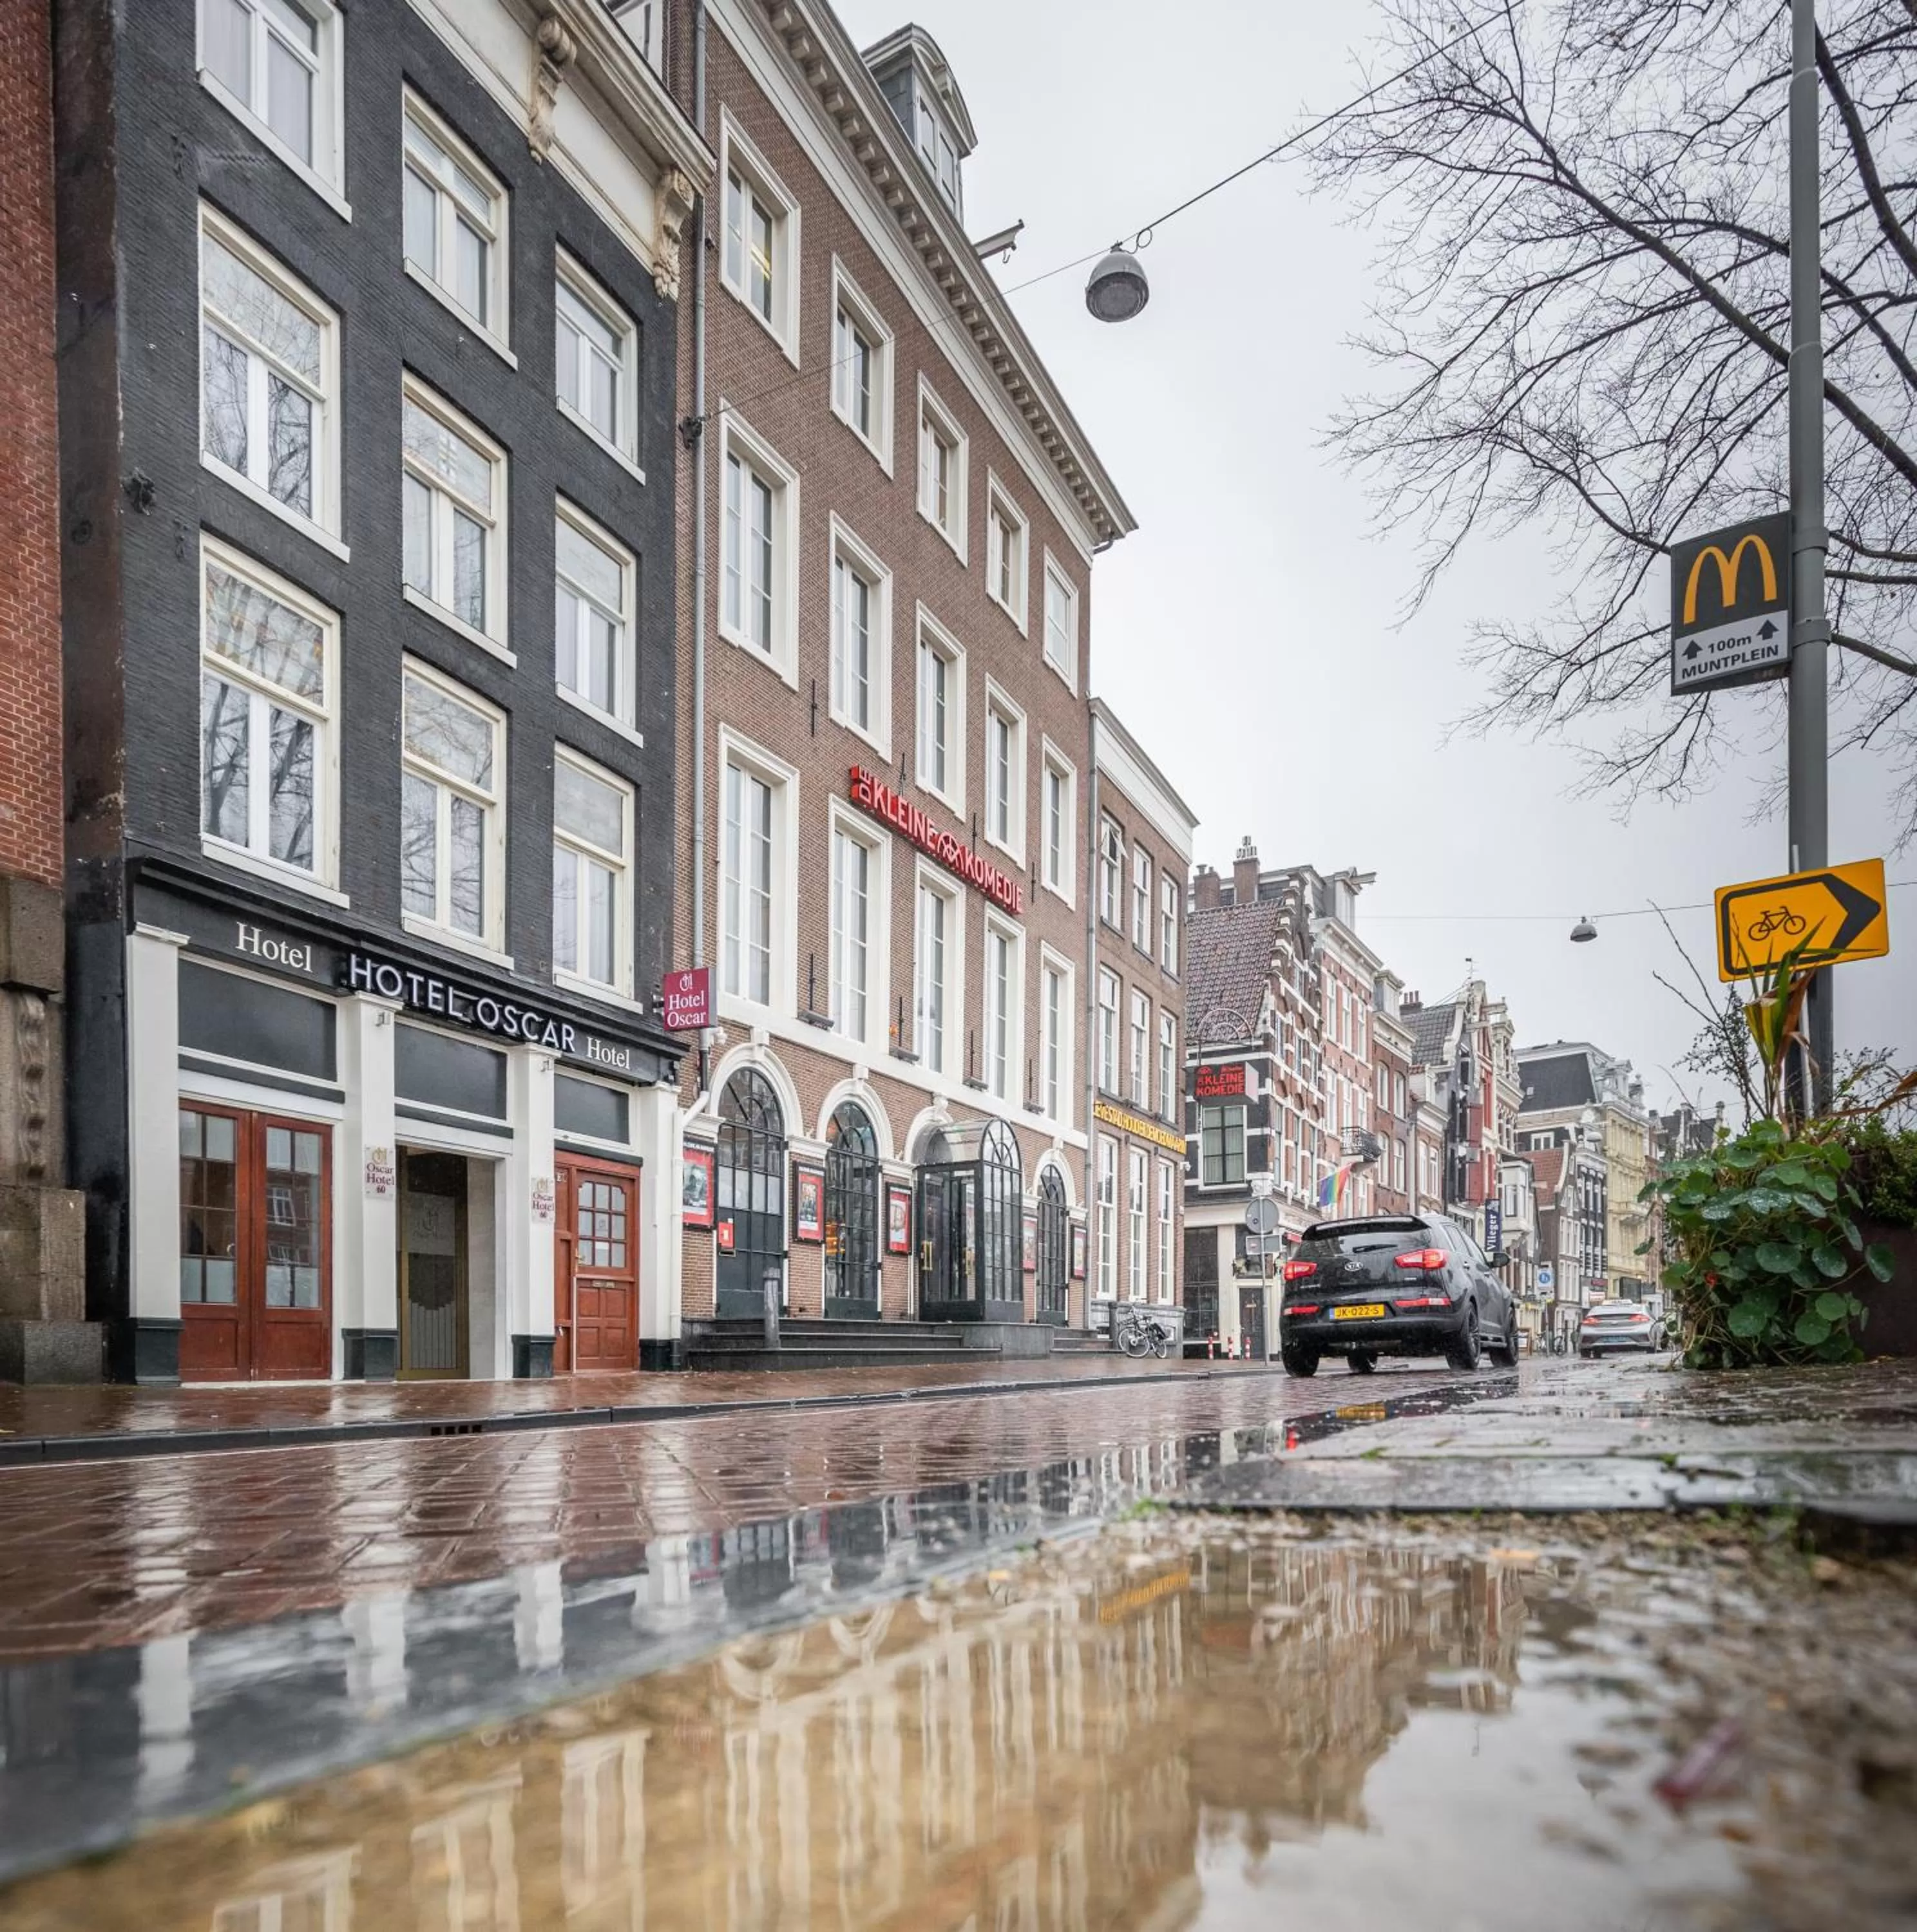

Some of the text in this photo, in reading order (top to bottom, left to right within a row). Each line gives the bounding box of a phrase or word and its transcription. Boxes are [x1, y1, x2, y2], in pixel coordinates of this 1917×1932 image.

[1708, 635, 1752, 654] 100m
[1681, 644, 1779, 679] MUNTPLEIN
[859, 769, 1024, 914] DE KLEINE KOMEDIE
[235, 922, 313, 973] Hotel
[350, 952, 576, 1053] HOTEL OSCAR
[668, 990, 705, 1011] Hotel
[667, 1011, 707, 1028] Oscar
[586, 1036, 631, 1070] Hotel
[1205, 1071, 1245, 1086] KLEINE
[1196, 1083, 1245, 1097] KOMEDIE
[367, 1162, 395, 1174] Oscar
[367, 1173, 395, 1186] Hotel
[1486, 1214, 1499, 1251] Vlieger
